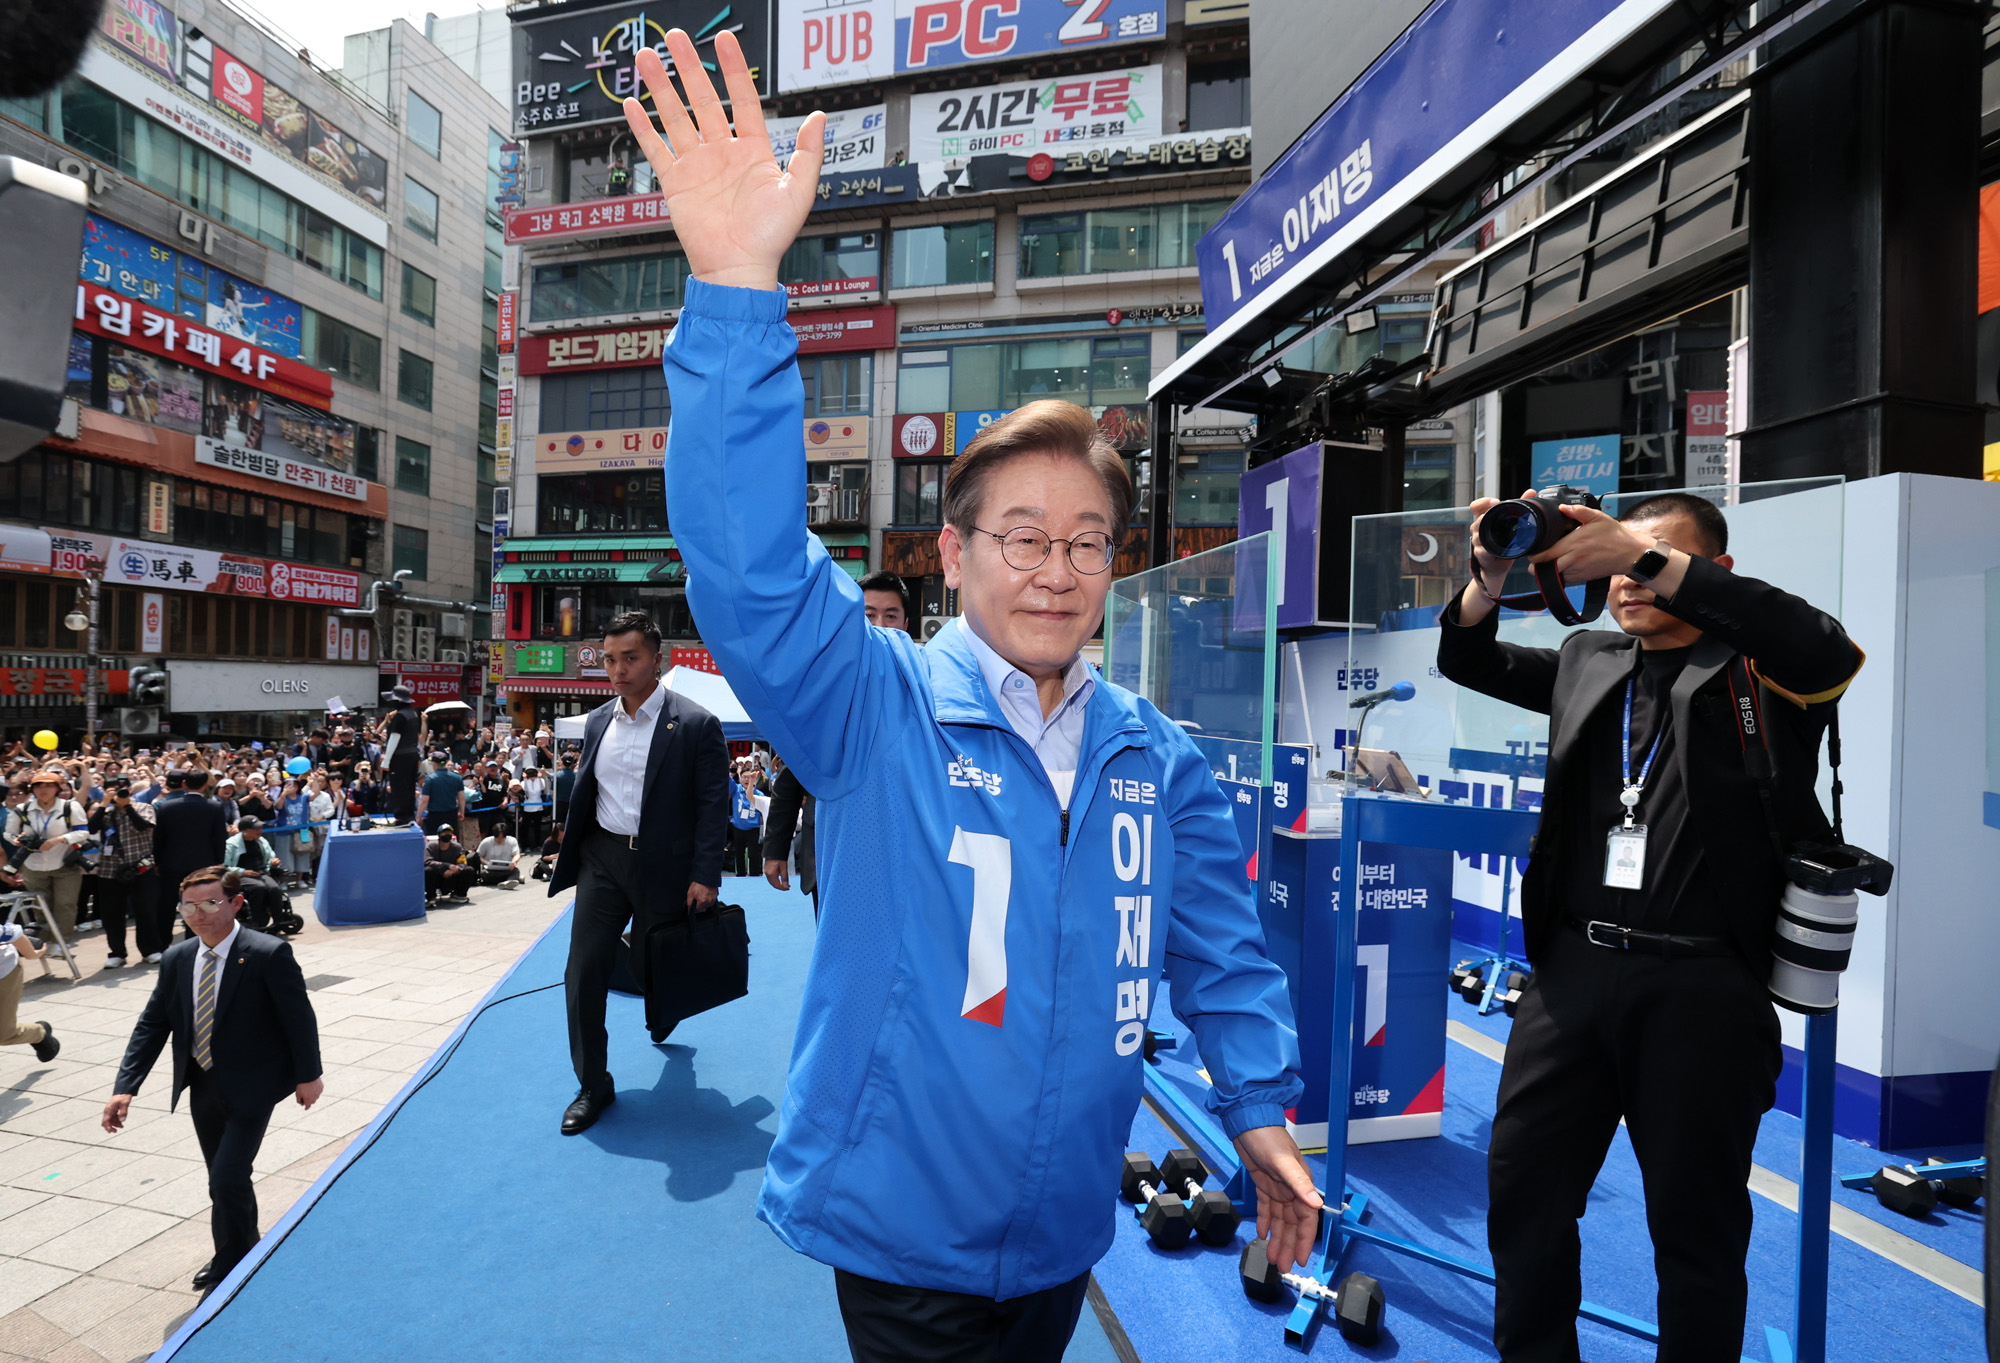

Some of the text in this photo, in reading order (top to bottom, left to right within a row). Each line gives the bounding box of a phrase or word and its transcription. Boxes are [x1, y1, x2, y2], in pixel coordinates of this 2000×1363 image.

[802, 10, 873, 70] PUB
[908, 0, 1019, 67] PC
[518, 81, 561, 106] Bee
[937, 76, 1133, 133] 2시간 무료
[176, 105, 212, 131] LUXURY
[862, 113, 883, 130] 6F
[1064, 134, 1250, 173] 코인 노래연습장
[838, 176, 882, 197] 고양이
[530, 213, 553, 233] 그냥
[559, 210, 583, 229] 작고
[589, 204, 626, 226] 소박한
[1222, 138, 1373, 302] 1 지금은 이재명
[150, 246, 170, 263] 5F
[119, 270, 162, 301] 안마
[844, 281, 870, 291] Lounge
[76, 286, 277, 380] 임카페 4F
[941, 323, 967, 331] Medicine
[968, 321, 985, 329] Clinic
[547, 329, 670, 367] 보드게임카
[945, 414, 954, 454] IZAKAYA
[1219, 428, 1235, 437] shop
[286, 463, 328, 489] 안주가
[600, 458, 665, 468] IZAKAYA Hig
[1265, 476, 1290, 606] 1
[125, 556, 198, 583] 生 馬車
[523, 567, 619, 581] YAKITORI
[291, 581, 357, 603] 닭날개튀김
[491, 651, 503, 677] 노래
[261, 679, 309, 694] OLENS
[417, 681, 460, 694] 한신포차
[1337, 667, 1379, 691] 민주당
[1739, 695, 1756, 735] EOS R8
[488, 780, 503, 792] Lee
[948, 762, 1003, 796] 민주당
[1109, 778, 1156, 805] 지금은
[1332, 863, 1395, 886] 부터
[1366, 888, 1428, 910] 대한민국
[947, 824, 1012, 1029] 1
[1111, 812, 1153, 1057] 이재명
[1356, 944, 1389, 1047] 1
[1354, 1089, 1391, 1105] 민주당
